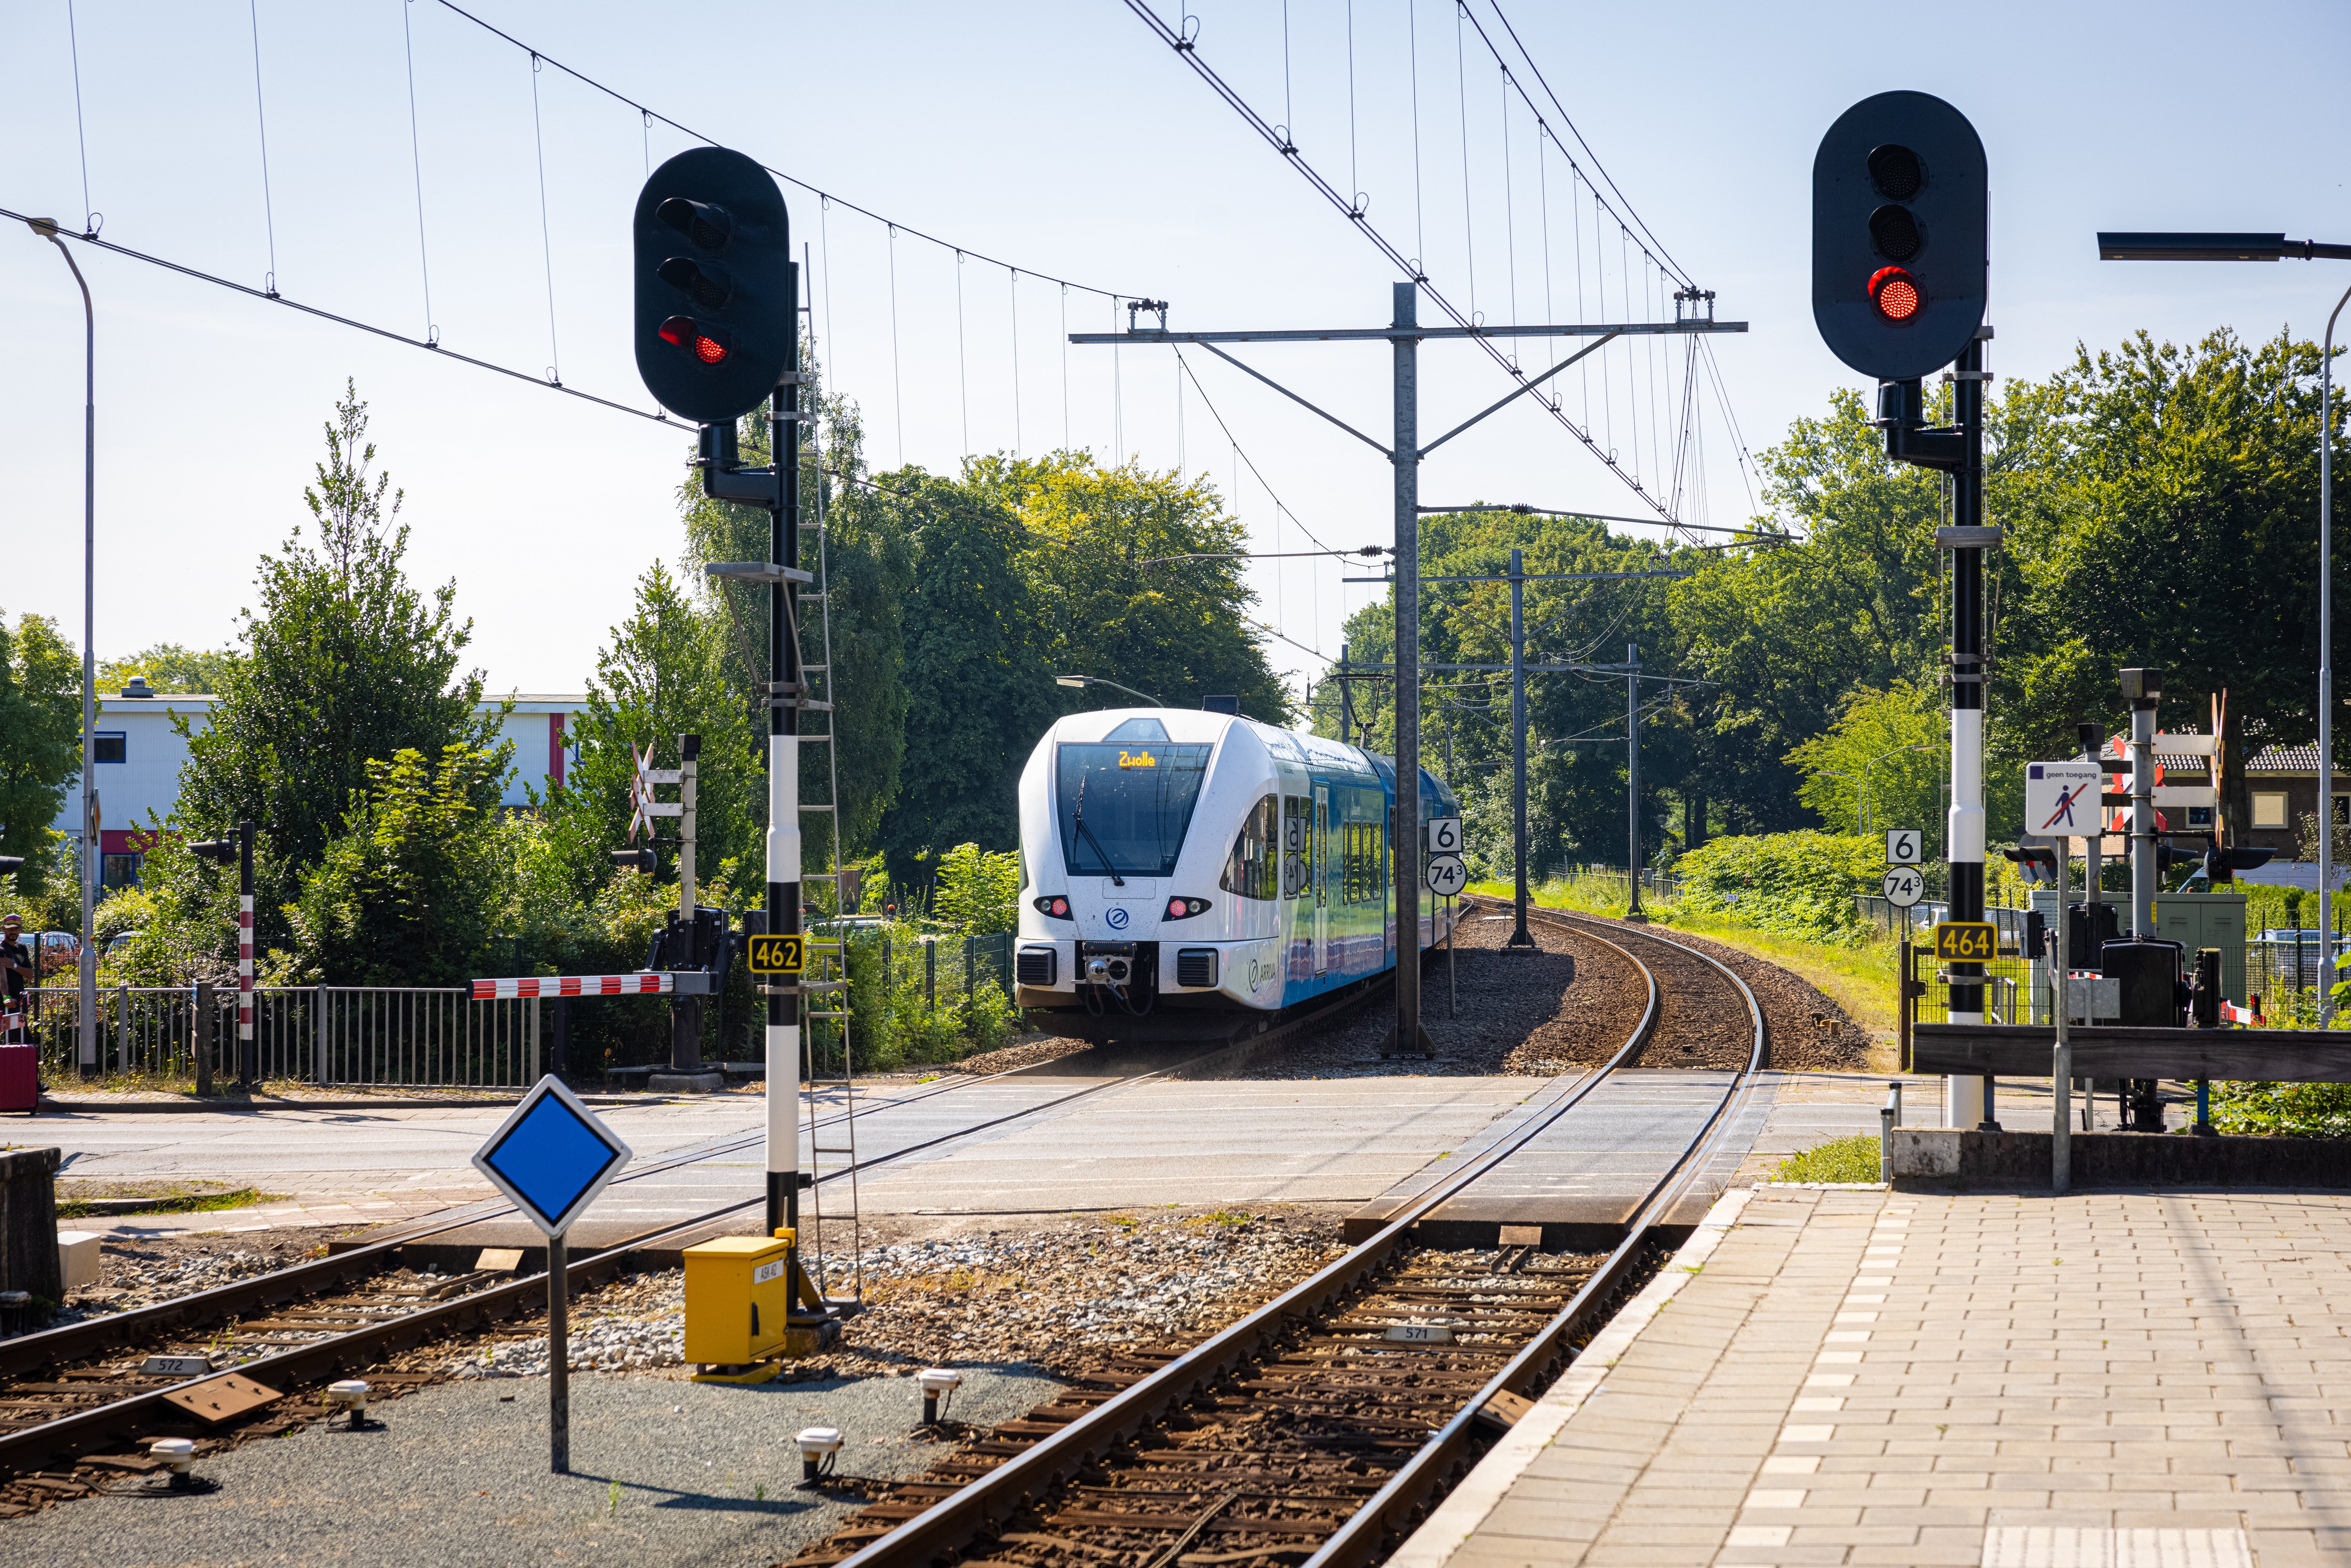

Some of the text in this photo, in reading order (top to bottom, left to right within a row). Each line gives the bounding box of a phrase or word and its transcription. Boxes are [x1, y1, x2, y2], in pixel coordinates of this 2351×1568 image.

[1119, 751, 1155, 766] Zwolle
[1437, 822, 1454, 848] 6
[1895, 834, 1913, 859] 6
[1943, 930, 1989, 955] 464
[756, 942, 797, 967] 462
[1260, 963, 1276, 981] ARRIVA
[1406, 1328, 1428, 1339] 571
[158, 1359, 183, 1371] 572
